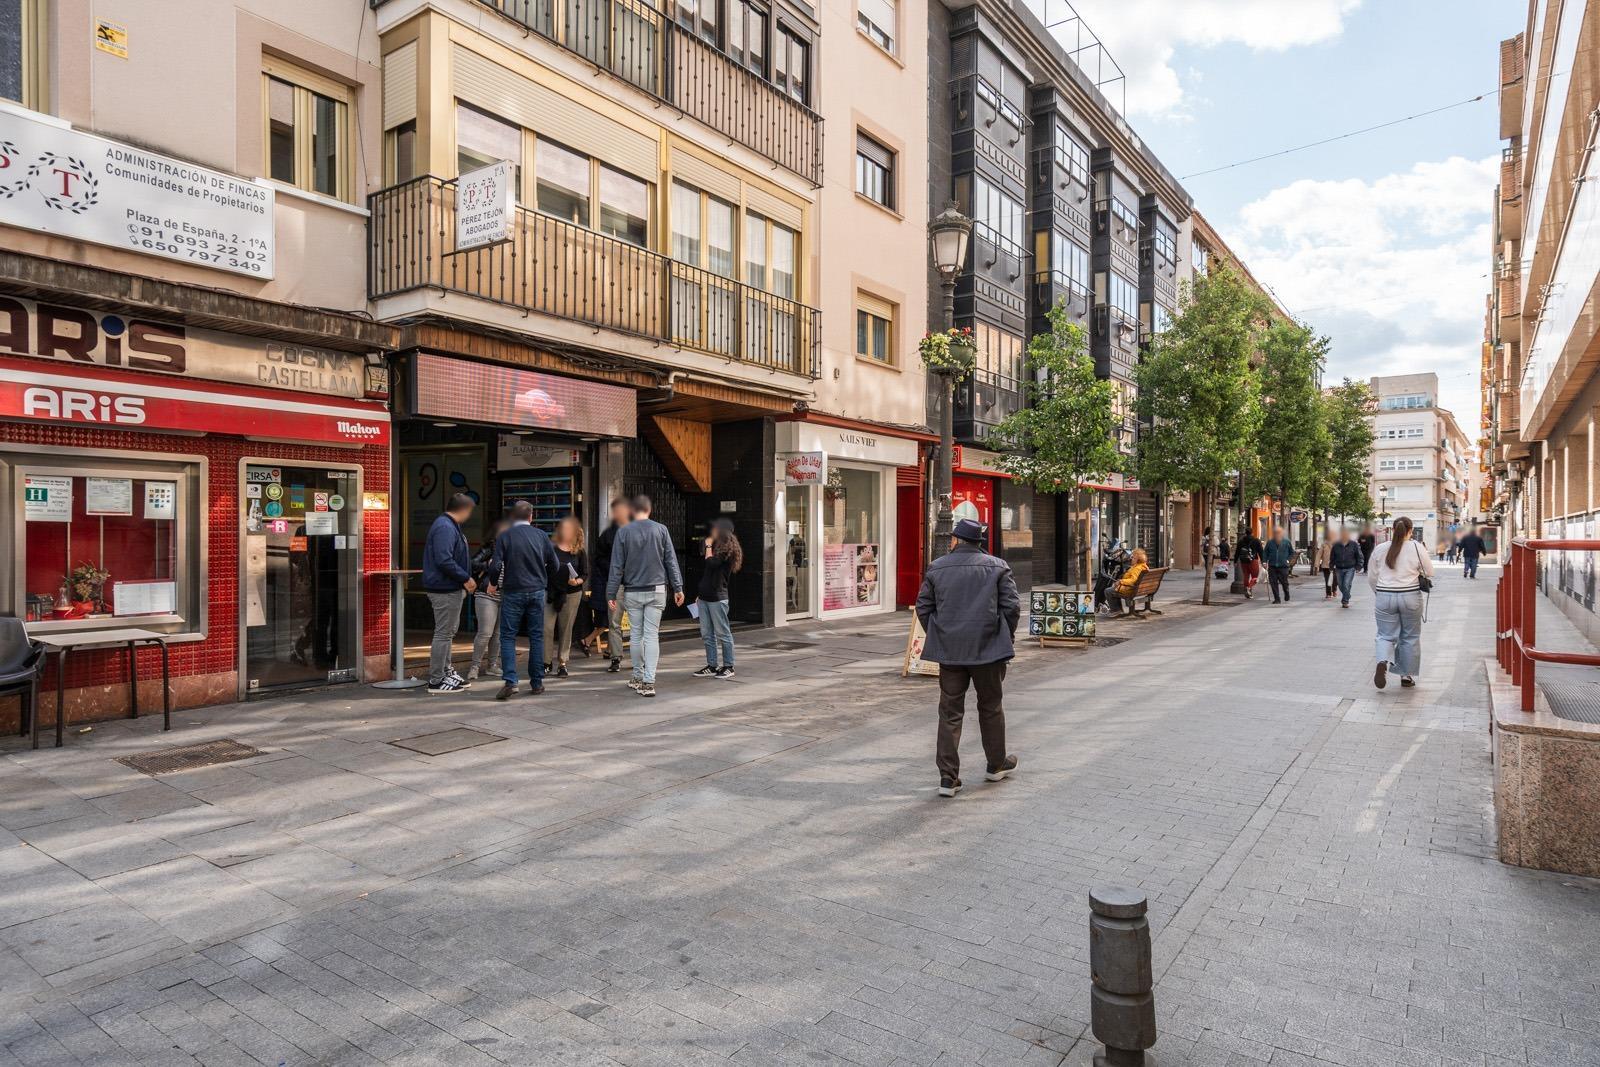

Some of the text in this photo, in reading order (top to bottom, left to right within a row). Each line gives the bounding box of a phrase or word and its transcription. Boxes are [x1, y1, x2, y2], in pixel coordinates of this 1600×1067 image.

[52, 168, 80, 198] T
[105, 163, 265, 215] Comunidades de Propietarios
[106, 148, 266, 201] ADMINISTRACIÓN DE FINCAS
[126, 208, 160, 226] Plaza
[164, 215, 178, 230] de
[183, 222, 228, 243] España,
[231, 233, 238, 244] 2
[249, 238, 268, 251] 1ºA
[466, 219, 499, 236] ABOGADOS
[141, 226, 267, 262] 91 693 22 02
[141, 239, 261, 273] 650 797 349
[266, 343, 352, 373] COCINA
[257, 363, 359, 396] CASTELLANA
[336, 421, 380, 434] Mahou
[839, 433, 860, 445] NAILS
[29, 488, 43, 500] H
